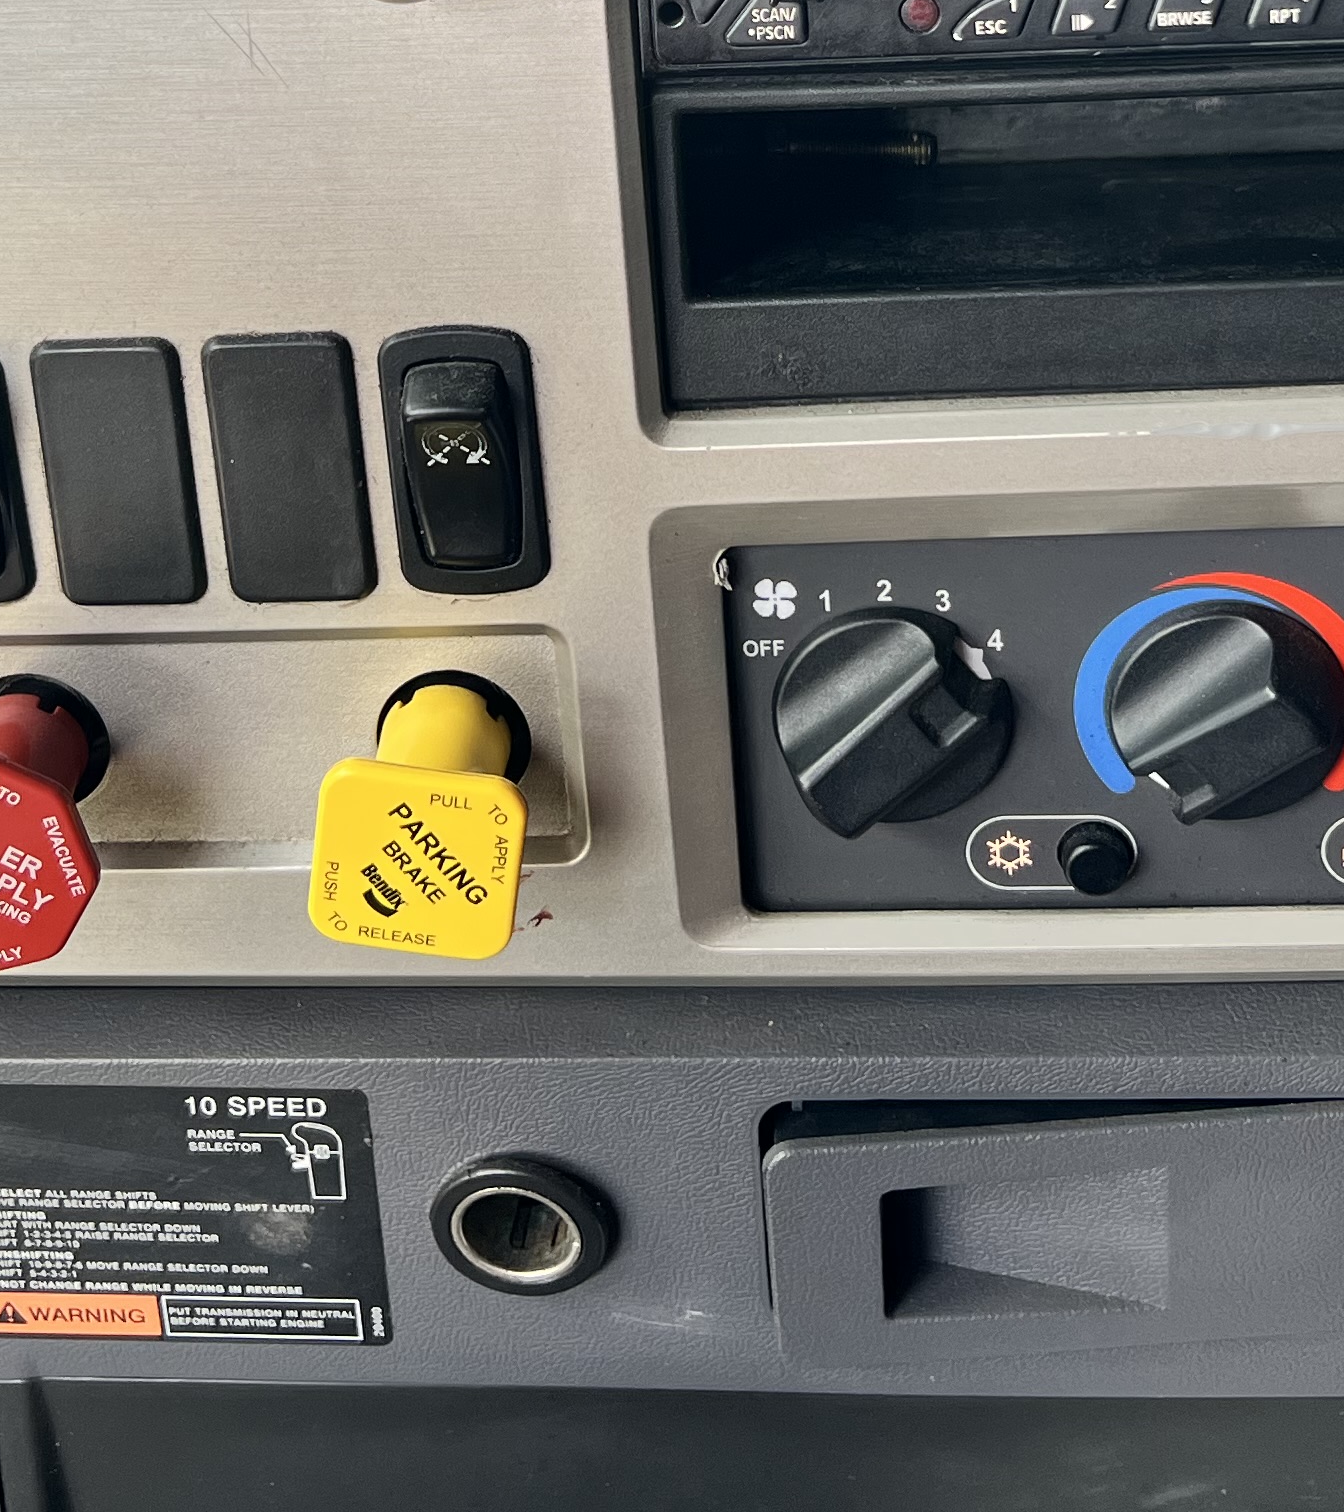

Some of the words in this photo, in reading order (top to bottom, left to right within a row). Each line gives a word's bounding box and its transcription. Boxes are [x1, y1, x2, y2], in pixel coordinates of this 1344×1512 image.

[750, 6, 797, 24] SCAN/
[1157, 10, 1213, 27] BRWSE
[1269, 7, 1301, 24] RPT
[974, 19, 1007, 36] ESC
[876, 579, 893, 602] 2
[819, 590, 832, 612] 1
[935, 590, 951, 613] 3
[742, 639, 785, 658] OFF
[986, 629, 1004, 652] 4
[429, 792, 473, 811] PULL
[487, 803, 508, 826] TO
[42, 815, 87, 898] EVACUATE
[387, 802, 489, 906] PARKING
[491, 834, 509, 885] APPLY
[323, 860, 340, 902] PUSH
[381, 840, 447, 906] BRAKE
[360, 862, 407, 911] Bendix
[327, 910, 348, 932] TO
[358, 925, 437, 947] RELEASE
[183, 1096, 217, 1117] 10
[227, 1096, 328, 1118] SPEED
[186, 1129, 236, 1141] RANGE
[188, 1141, 262, 1154] SELECTOR
[45, 1189, 67, 1199] ALL
[70, 1190, 112, 1200] RANGE
[115, 1191, 157, 1201] SHIFTS
[18, 1198, 60, 1208] RANGE
[63, 1199, 126, 1209] SELECTOR
[128, 1200, 181, 1211] BEFORE
[184, 1201, 232, 1212] MOVING
[234, 1202, 269, 1213] SHIFT
[271, 1203, 315, 1214] LEVER)
[20, 1220, 52, 1230] WITH
[54, 1221, 97, 1231] RANGE
[99, 1222, 161, 1232] SELECTOR
[164, 1223, 201, 1233] DOWN
[75, 1231, 111, 1240] RAISE
[113, 1231, 155, 1241] RANGE
[158, 1232, 220, 1243] SELECTOR
[85, 1261, 121, 1271] MOVE
[123, 1262, 164, 1272] RANGE
[167, 1263, 229, 1274] SELECTOR
[231, 1264, 269, 1274] DOWN
[0, 1279, 26, 1289] NOT
[29, 1280, 82, 1290] CHANGE
[85, 1281, 129, 1292] RANGE
[131, 1282, 172, 1292] WHILE
[175, 1283, 226, 1294] MOVING
[228, 1284, 242, 1294] IN
[245, 1284, 303, 1296] REVERSE
[28, 1306, 146, 1324] WARNING
[168, 1306, 192, 1317] PUT
[195, 1307, 282, 1318] TRANSMISSION
[285, 1309, 299, 1319] IN
[302, 1309, 355, 1320] NEUTRAL
[170, 1316, 216, 1327] BEFORE
[219, 1317, 277, 1328] STARTING
[280, 1319, 326, 1329] ENGINE
